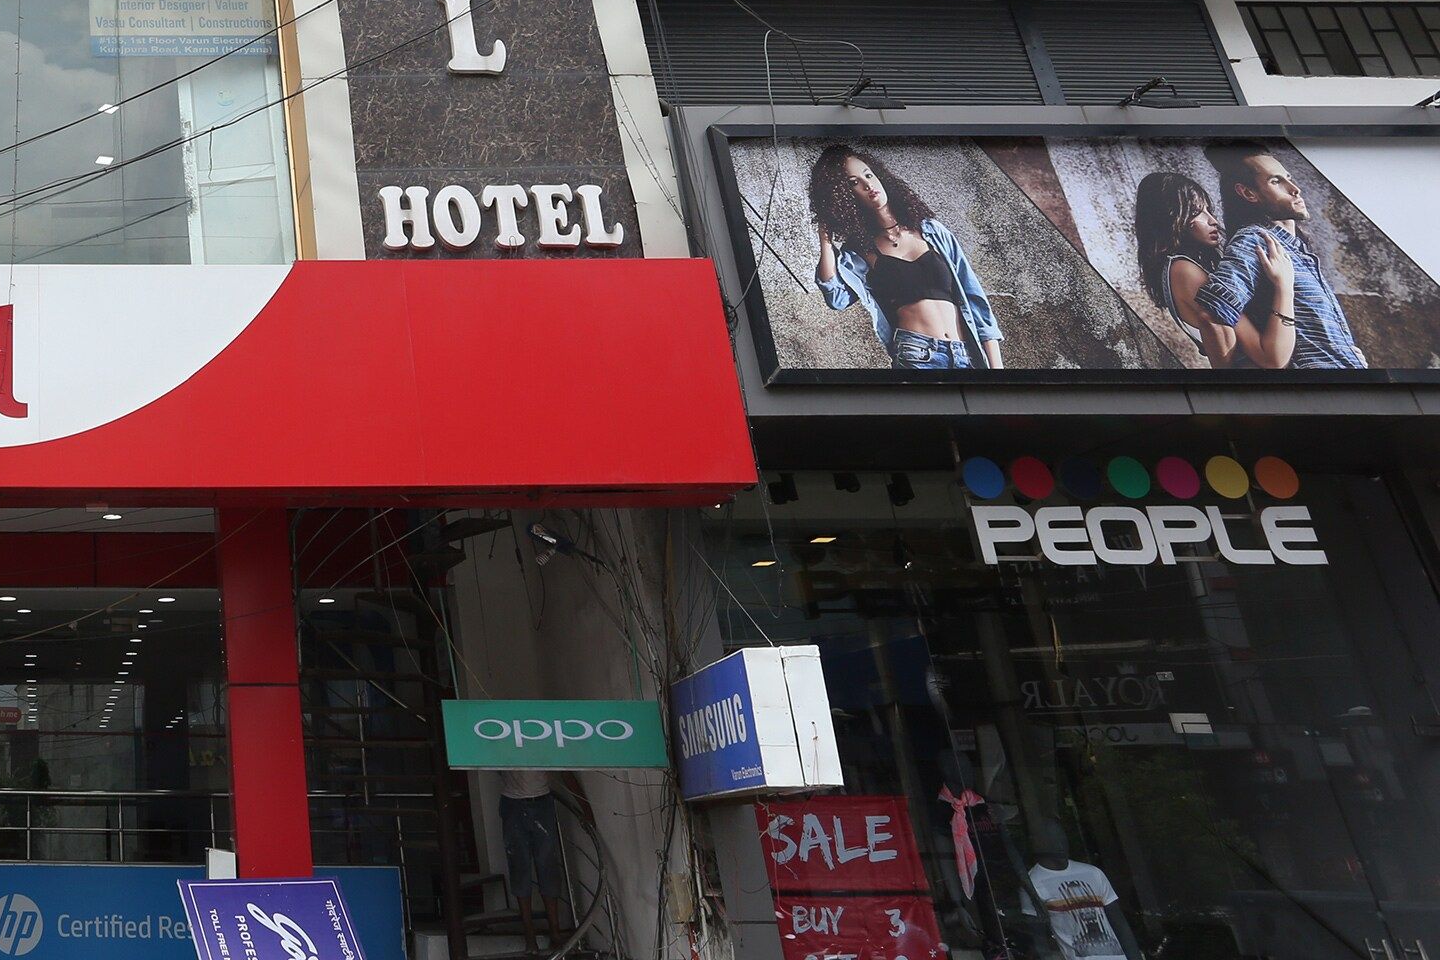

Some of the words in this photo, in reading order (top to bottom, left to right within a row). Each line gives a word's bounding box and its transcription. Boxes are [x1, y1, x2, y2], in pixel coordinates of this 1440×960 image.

[116, 0, 155, 11] Interior
[215, 0, 249, 11] Valuer
[128, 16, 186, 29] Consultant
[199, 16, 273, 29] Constructions
[149, 37, 176, 45] Floor
[177, 37, 210, 46] Varun
[184, 46, 220, 54] Karnal
[378, 183, 625, 251] HOTEL
[969, 505, 1330, 566] PEOPLE
[678, 693, 748, 760] SAMSUNG
[767, 813, 898, 871] SALE
[57, 914, 152, 939] Certified
[209, 908, 224, 934] TOLL
[791, 905, 846, 936] BUY
[884, 908, 906, 938] 3
[216, 932, 230, 957] FREE
